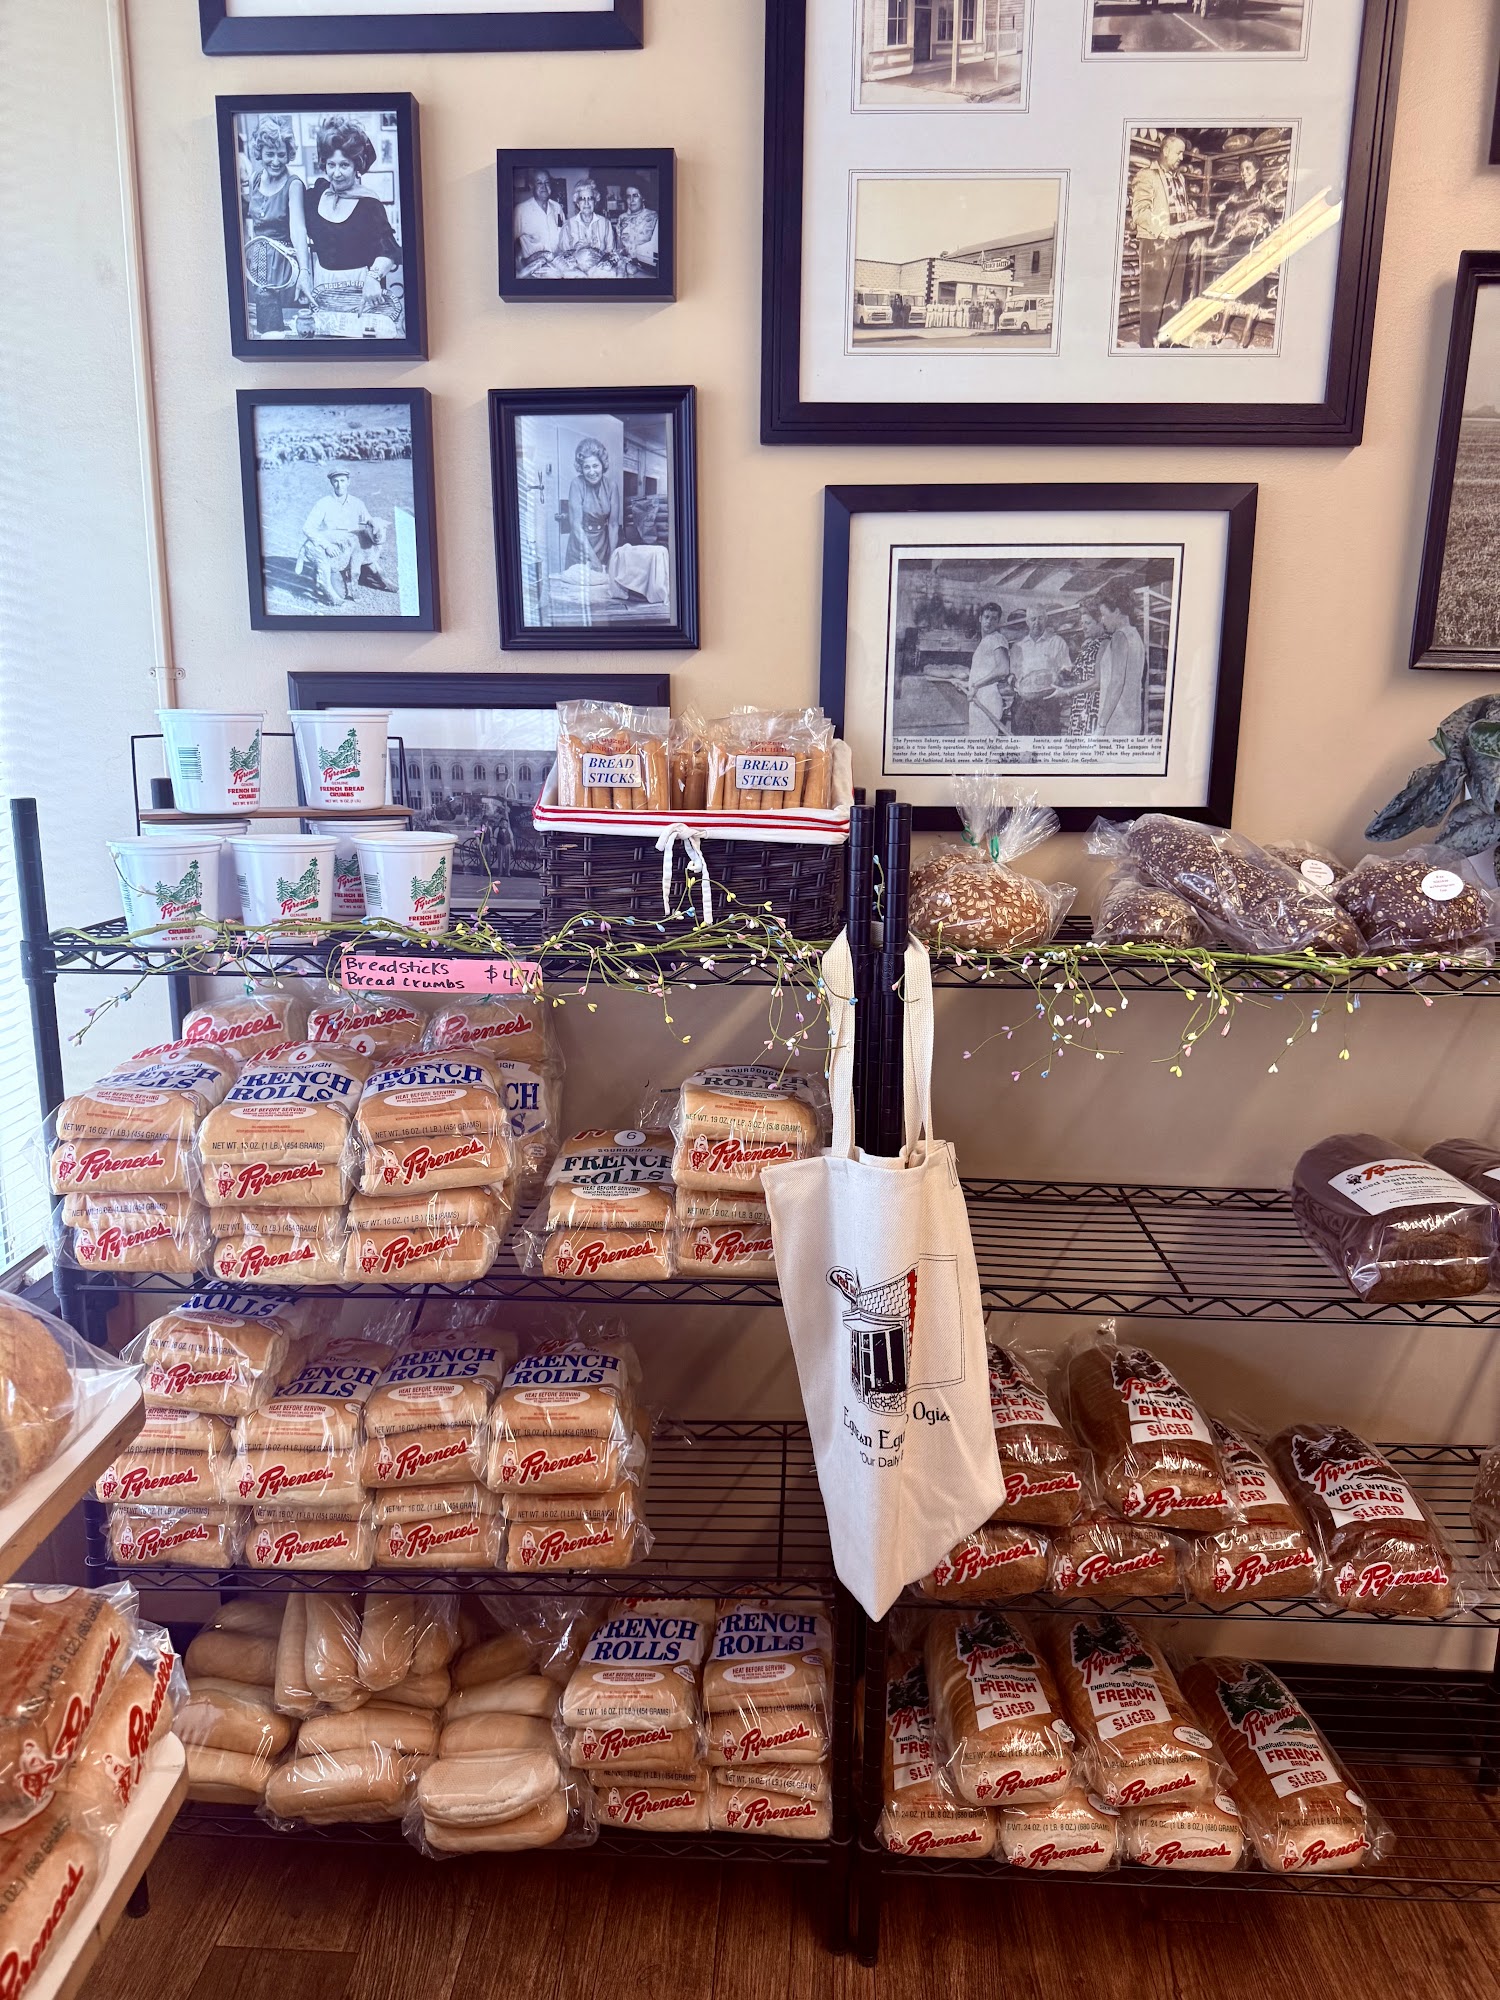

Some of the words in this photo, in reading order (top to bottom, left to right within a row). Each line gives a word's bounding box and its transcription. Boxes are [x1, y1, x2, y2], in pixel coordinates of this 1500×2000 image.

[323, 766, 359, 782] Pyrenees
[588, 757, 634, 769] BREAD
[742, 759, 789, 772] BREAD
[588, 772, 635, 784] STICKS
[741, 774, 789, 788] STICKS
[161, 900, 200, 920] Pyrenees
[281, 896, 319, 915] Pyrenees
[345, 971, 395, 986] Bread
[403, 977, 465, 988] crumbs
[314, 1007, 415, 1042] Pyrenees
[296, 1050, 307, 1060] 6
[356, 1041, 367, 1053] 6
[365, 1063, 485, 1091] FRENCH
[228, 1085, 334, 1102] ROLLS
[300, 1142, 325, 1150] GRAMS)
[626, 1132, 637, 1140] 6
[76, 1149, 164, 1183] Pyrenees
[403, 1139, 484, 1185] Pyrenees
[708, 1139, 793, 1172] Pyrenees
[237, 1162, 323, 1199] Pyrenees
[572, 1168, 664, 1184] ROLLS
[1351, 1181, 1380, 1195] Sliced
[100, 1223, 171, 1261] Pyrenees
[382, 1230, 458, 1273] Pyrenees
[712, 1231, 773, 1264] Pyrene
[239, 1245, 316, 1278] Pyrenees
[575, 1240, 657, 1275] Pyrenees
[383, 1348, 499, 1373] FRENCH
[386, 1363, 480, 1383] ROLLS
[508, 1354, 621, 1374] FRENCH
[164, 1363, 237, 1395] Pyrenees
[511, 1369, 605, 1386] ROLLS
[996, 1410, 1044, 1423] SLICED
[1147, 1423, 1193, 1436] SLICED
[395, 1439, 469, 1479] Pyrenees
[519, 1447, 597, 1484] Pyrenees
[119, 1467, 198, 1499] Pyrenees
[256, 1465, 333, 1499] Pyrenees
[1314, 1458, 1384, 1492] Pyrenees
[1141, 1486, 1228, 1517] Pyrenees
[1326, 1483, 1364, 1498] WHOLE
[1366, 1483, 1403, 1494] WHEAT
[1339, 1490, 1405, 1505] BREAD
[1353, 1505, 1404, 1520] SLICED
[137, 1525, 209, 1559] Pyrenees
[272, 1531, 348, 1564] Pyrenees
[406, 1523, 479, 1558] Pyrenees
[539, 1527, 614, 1564] Pyrenees
[954, 1540, 1037, 1583] Pyrenees
[1080, 1550, 1164, 1586] Pyrenees
[1233, 1548, 1315, 1590] Pyrenees
[1359, 1563, 1448, 1598] Pyrenees
[590, 1618, 699, 1641] FRENCH
[591, 1641, 681, 1660] ROLLS
[716, 1635, 804, 1657] ROLLS
[1082, 1643, 1144, 1684] Pyrenees
[980, 1680, 1037, 1695] FRENCH
[1090, 1681, 1120, 1691] ENRICHED
[1096, 1687, 1156, 1704] FRENCH
[649, 1708, 671, 1716] GRAMS)
[993, 1701, 1035, 1720] SLICED
[1120, 1700, 1141, 1708] BREAD
[1113, 1709, 1156, 1731] SLICED
[1243, 1704, 1301, 1745] Pyrenees
[600, 1727, 672, 1760] Pyrenees
[740, 1724, 810, 1761] Pyrenees
[1257, 1741, 1286, 1751] ENRICHED
[1265, 1748, 1324, 1763] FRENCH
[993, 1766, 1067, 1799] Pyrenees
[1120, 1773, 1196, 1805] Pyrenees
[1288, 1770, 1328, 1788] SLICED
[623, 1791, 695, 1823] Pyrenees
[742, 1796, 817, 1828] Pyrenees
[1187, 1822, 1191, 1830] 8
[1205, 1823, 1217, 1832] (680
[907, 1829, 982, 1854] Pyrenees
[1151, 1841, 1231, 1866] Pyrenees
[1299, 1835, 1371, 1869] Pyrenees
[1028, 1841, 1105, 1868] Pyrenees
